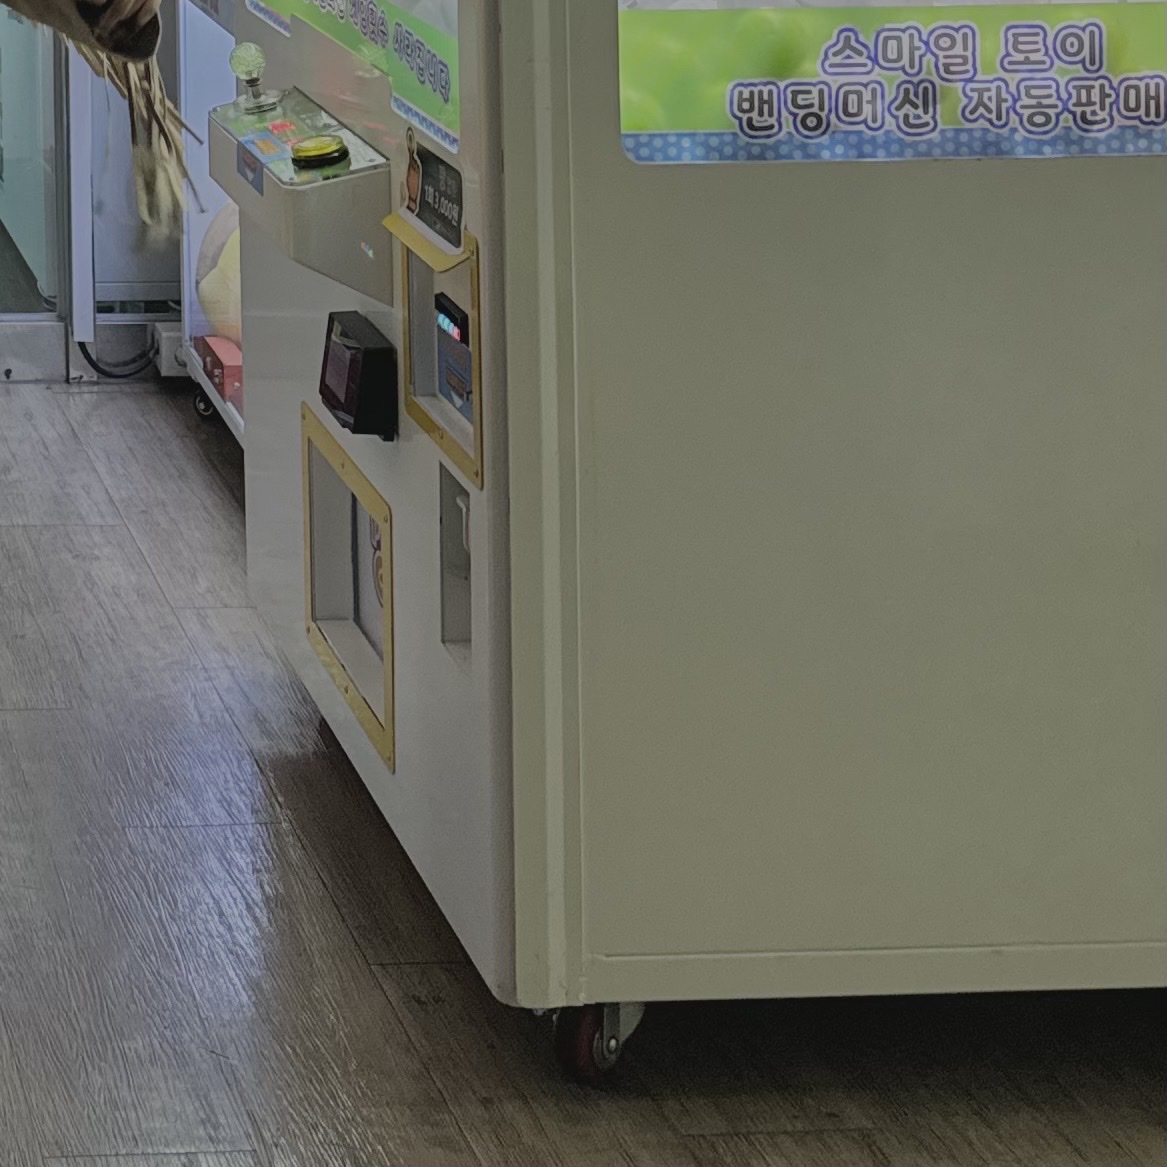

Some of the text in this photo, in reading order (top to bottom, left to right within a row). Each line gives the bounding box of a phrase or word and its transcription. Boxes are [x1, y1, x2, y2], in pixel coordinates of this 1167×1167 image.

[825, 26, 1099, 78] 스마일 토이
[734, 82, 934, 134] 밴딩머신
